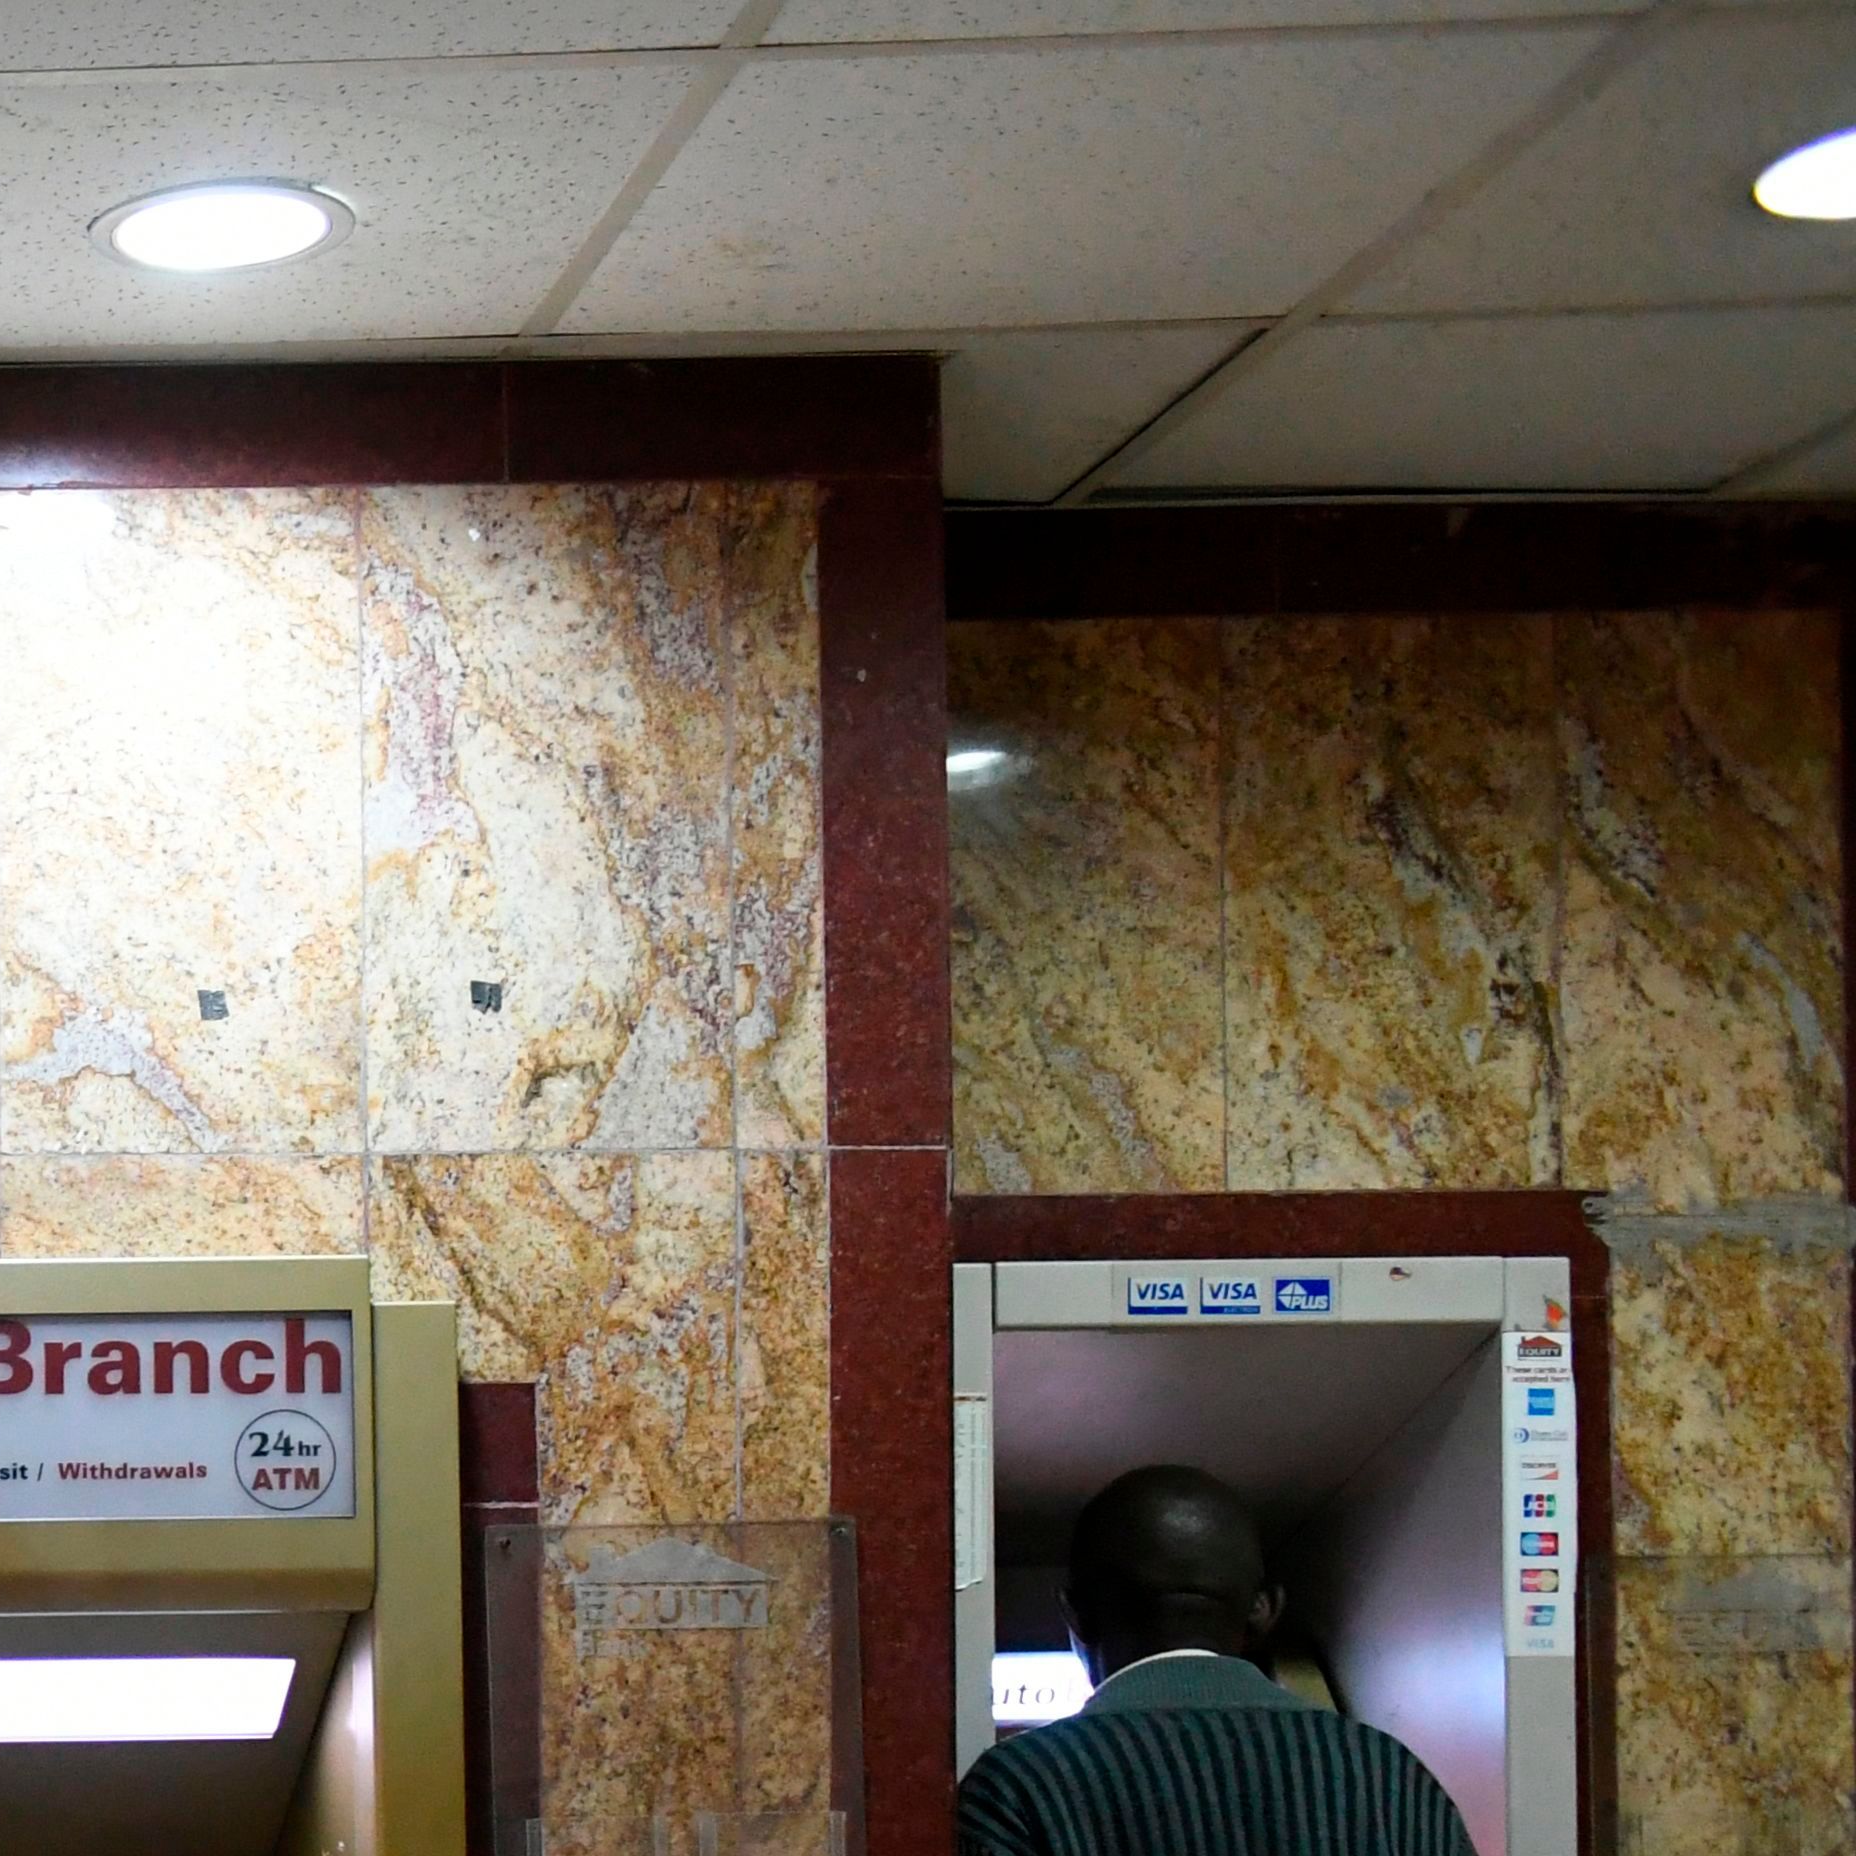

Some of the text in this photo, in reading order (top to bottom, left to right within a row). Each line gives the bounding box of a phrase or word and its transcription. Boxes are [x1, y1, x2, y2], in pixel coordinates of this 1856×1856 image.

[1137, 1283, 1328, 1309] VISA VISA PLUS
[37, 1463, 43, 1481] /
[58, 1462, 207, 1480] Withdrawals
[249, 1468, 322, 1493] ATM
[582, 1589, 760, 1625] EQUITY
